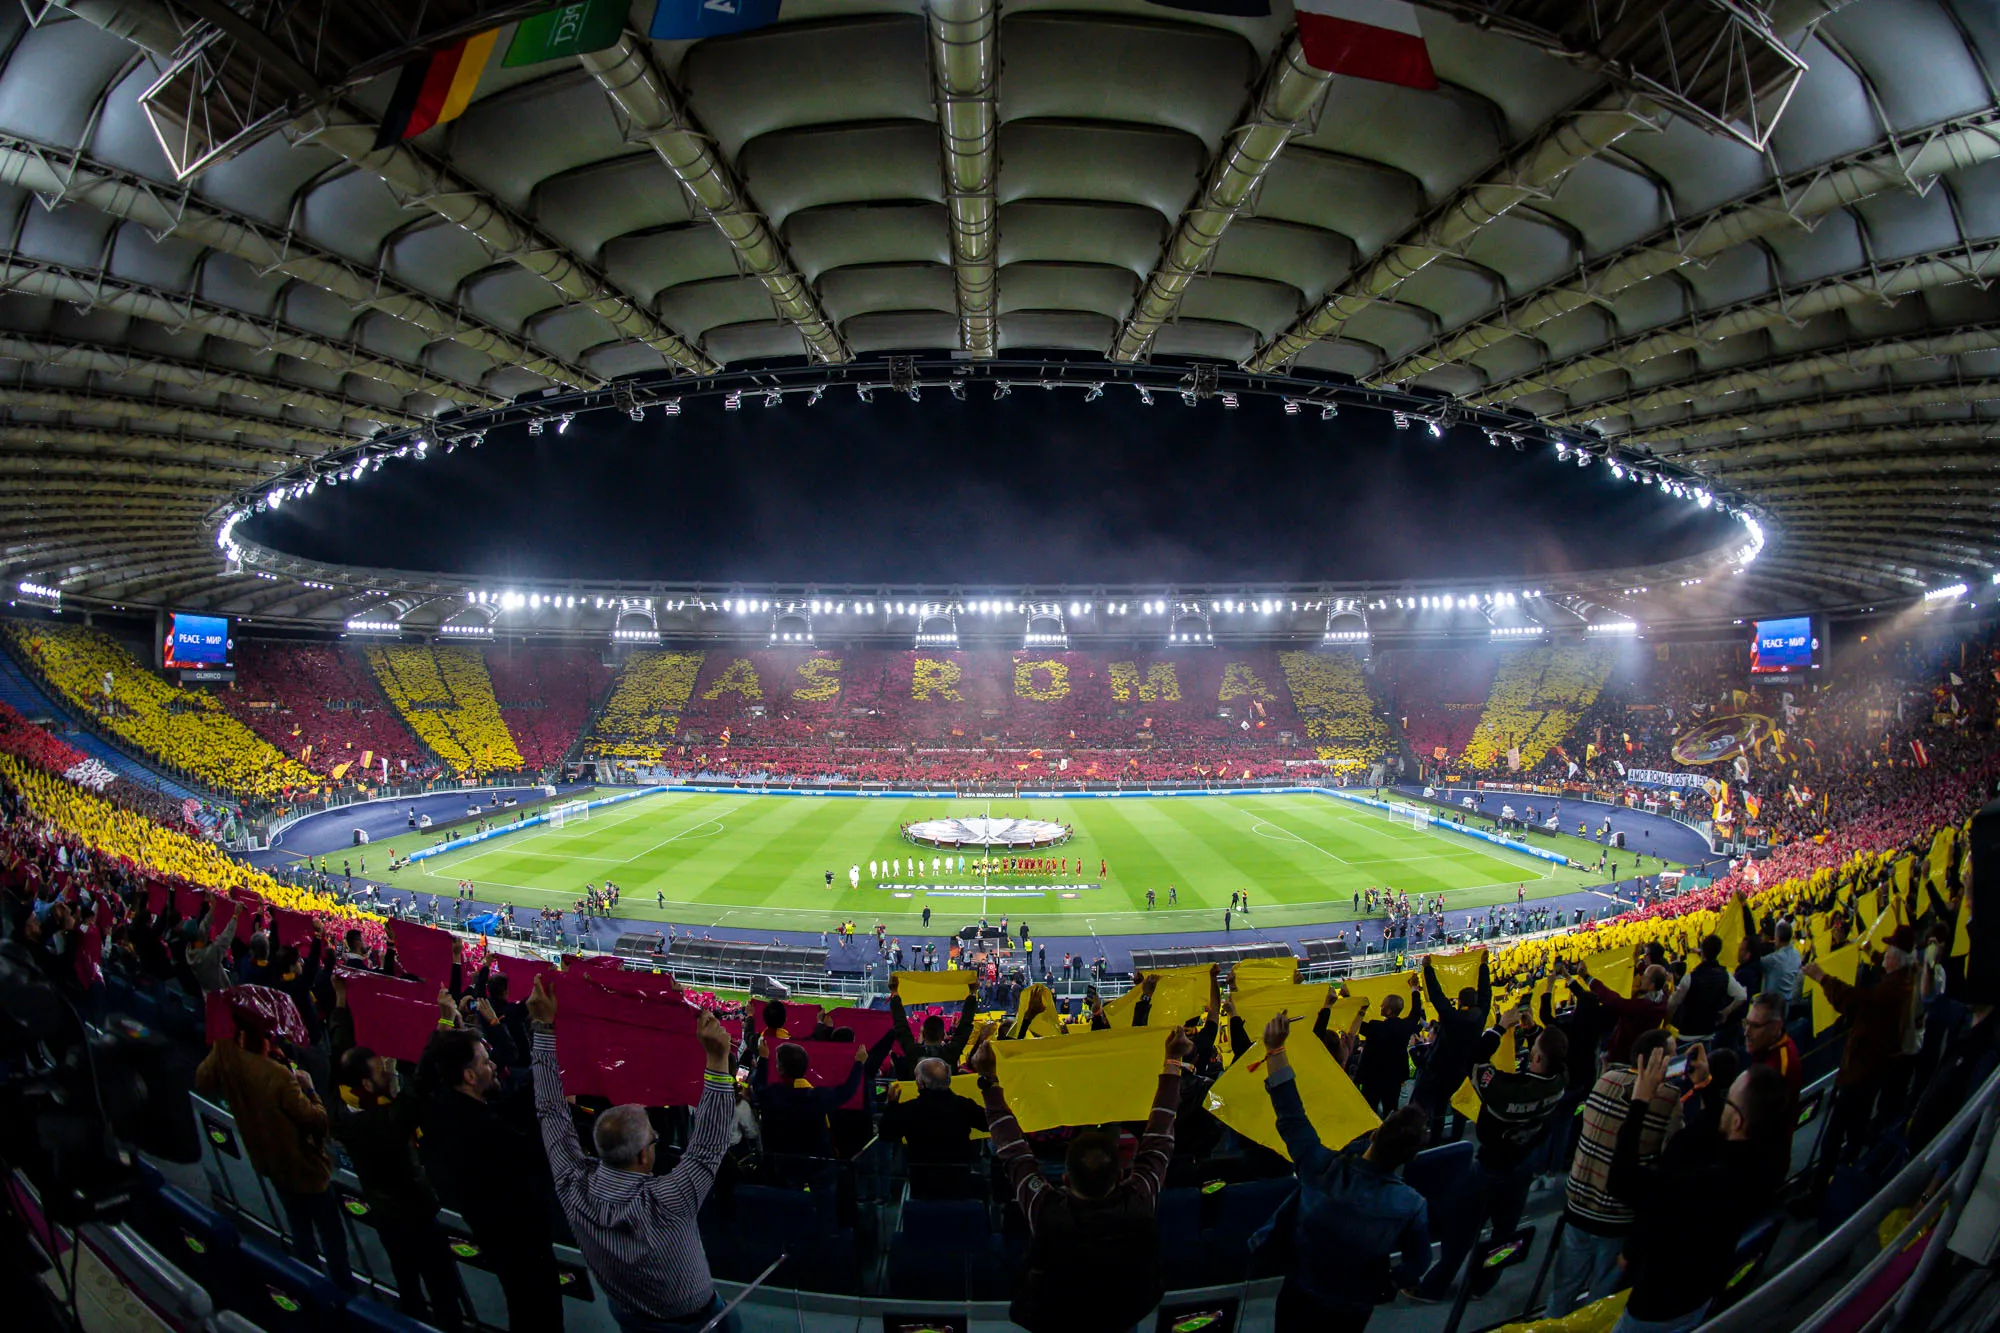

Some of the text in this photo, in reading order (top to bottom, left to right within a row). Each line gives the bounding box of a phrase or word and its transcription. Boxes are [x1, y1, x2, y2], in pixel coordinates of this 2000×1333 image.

[179, 634, 200, 644] PEACE
[1763, 638, 1783, 648] PEACE
[1629, 770, 1648, 781] AMOR
